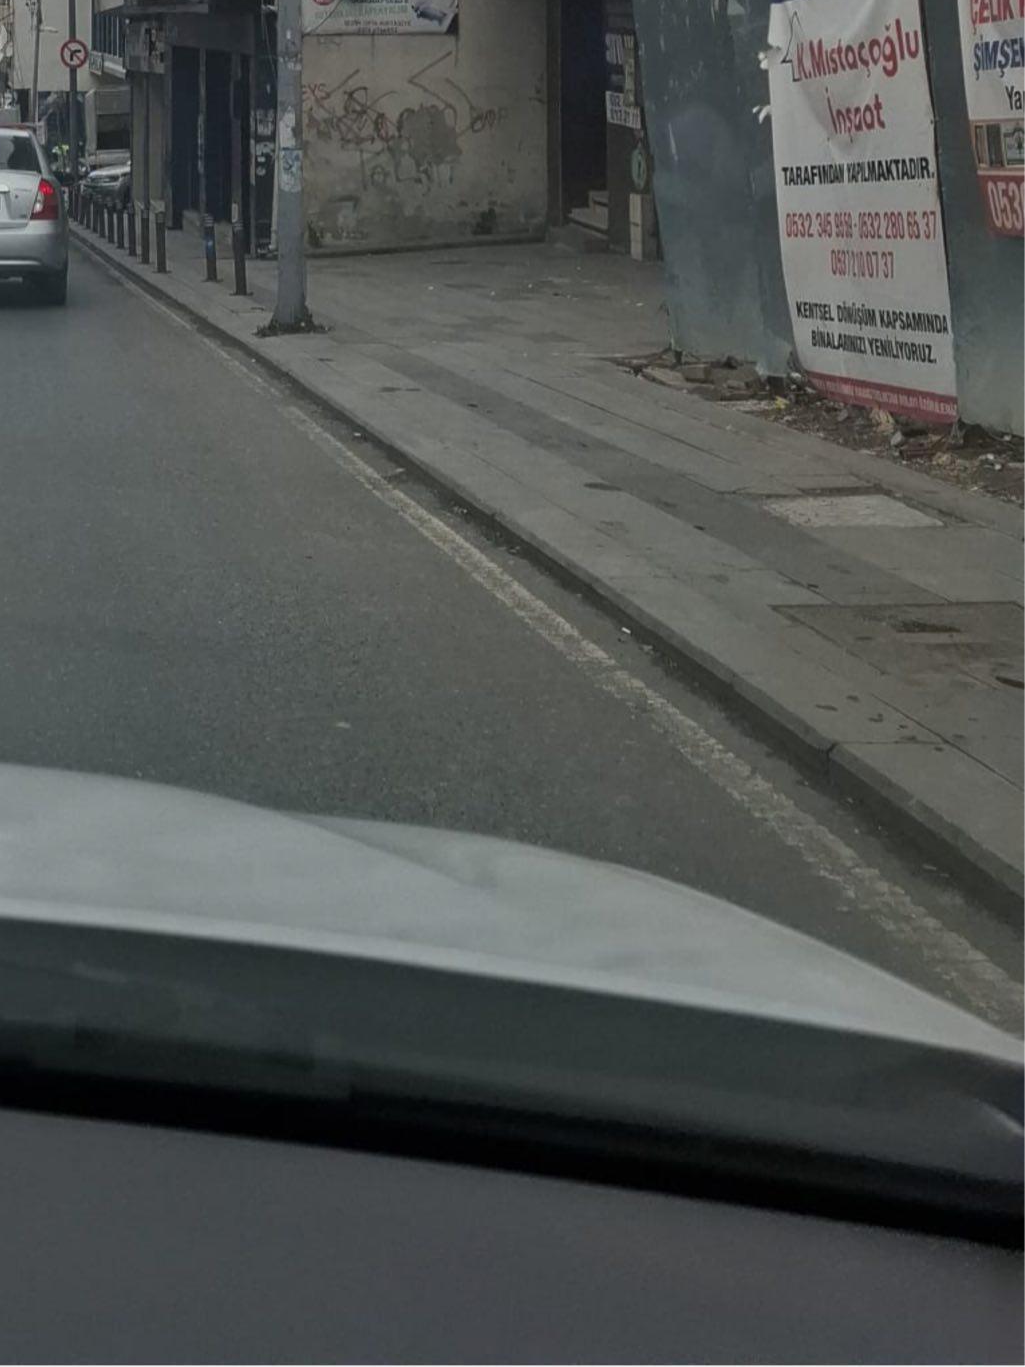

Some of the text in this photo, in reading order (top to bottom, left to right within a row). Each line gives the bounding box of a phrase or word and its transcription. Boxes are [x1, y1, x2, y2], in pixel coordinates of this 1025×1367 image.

[825, 87, 886, 143] İnşaat
[782, 156, 935, 186] TARAFINDAN YAPILMAKTADIR.
[785, 212, 814, 238] 0532
[883, 212, 905, 239] 280
[907, 211, 921, 240] 65
[922, 210, 937, 240] 37
[881, 251, 894, 279] 37
[796, 301, 949, 335] KENTSEL DÖNÜŞÜM KAPSAMINDA
